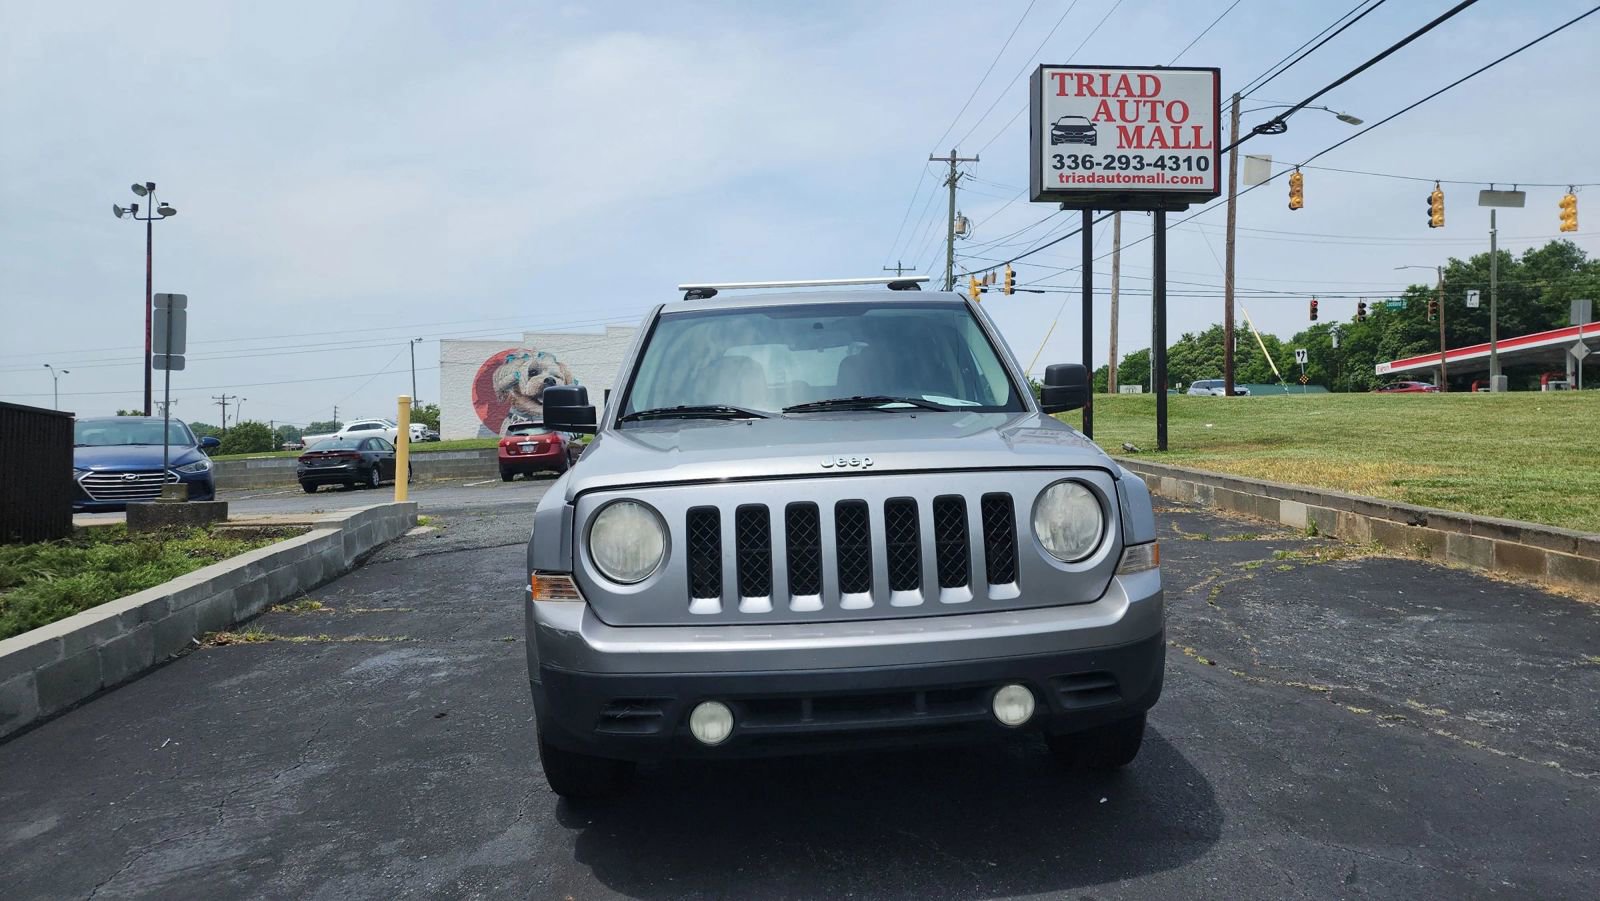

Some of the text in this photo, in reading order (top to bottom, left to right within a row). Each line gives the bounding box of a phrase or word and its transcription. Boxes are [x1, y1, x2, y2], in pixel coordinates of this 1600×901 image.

[1051, 72, 1162, 98] TRIAD
[1091, 99, 1190, 124] AUTO
[1116, 125, 1212, 150] MALL
[1052, 154, 1210, 171] 336-293-4310
[1058, 172, 1204, 184] triadautomall.com
[820, 455, 874, 469] Jeep
